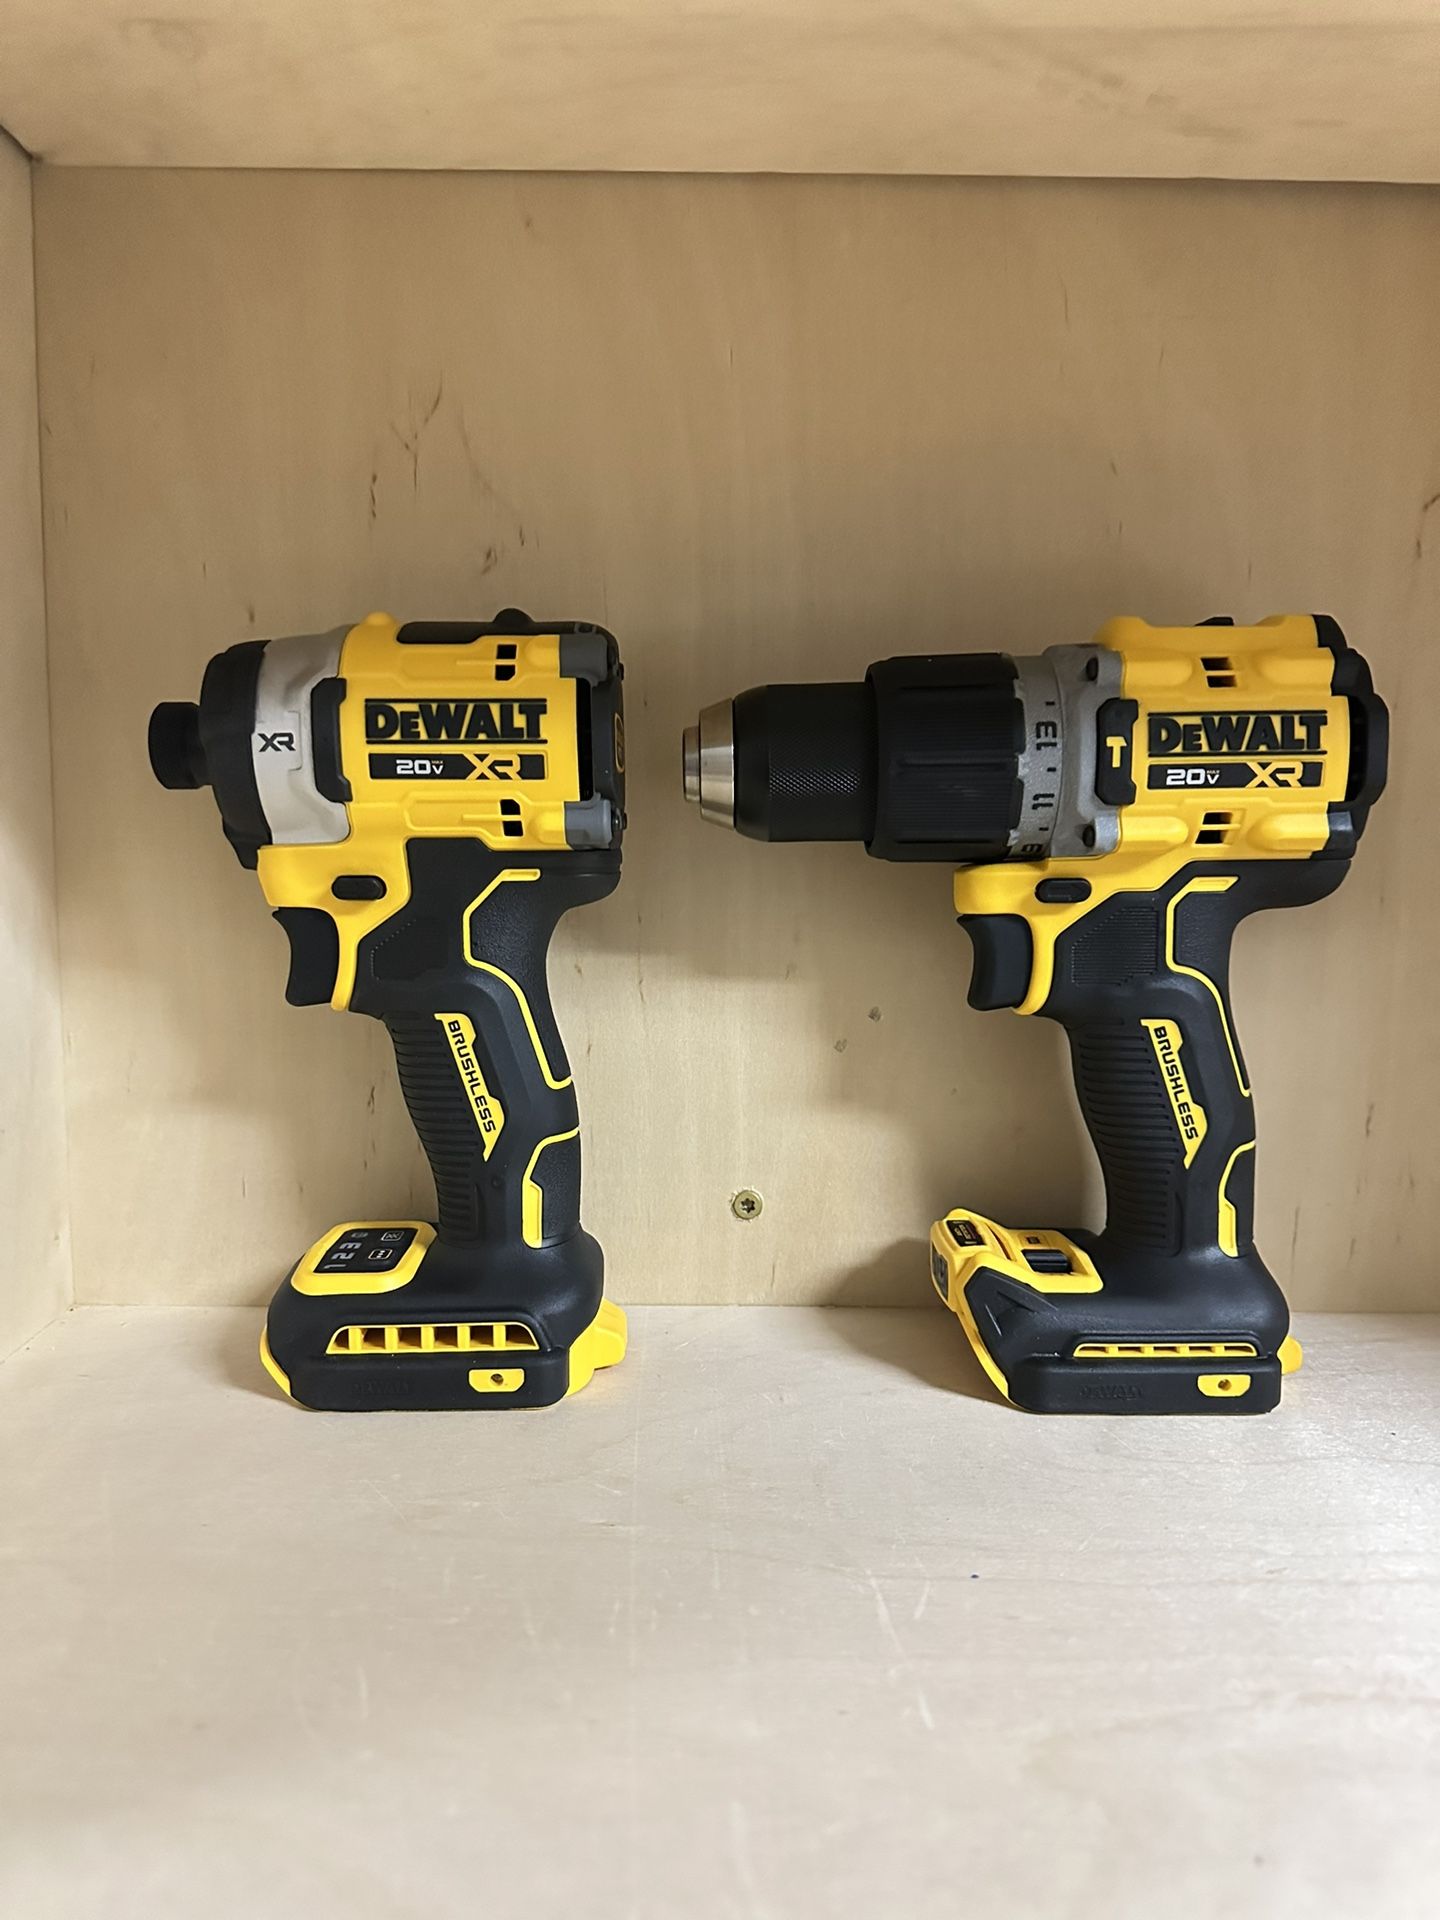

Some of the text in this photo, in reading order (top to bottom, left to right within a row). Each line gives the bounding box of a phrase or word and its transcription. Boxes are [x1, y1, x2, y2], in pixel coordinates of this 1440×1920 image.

[258, 732, 296, 752] XR
[1035, 720, 1057, 750] 13
[462, 752, 522, 780] XR
[1245, 761, 1304, 788] XR
[1032, 793, 1055, 810] 11
[448, 1020, 496, 1133] BRUSHLESS
[1154, 1026, 1199, 1140] BRUSHLESS
